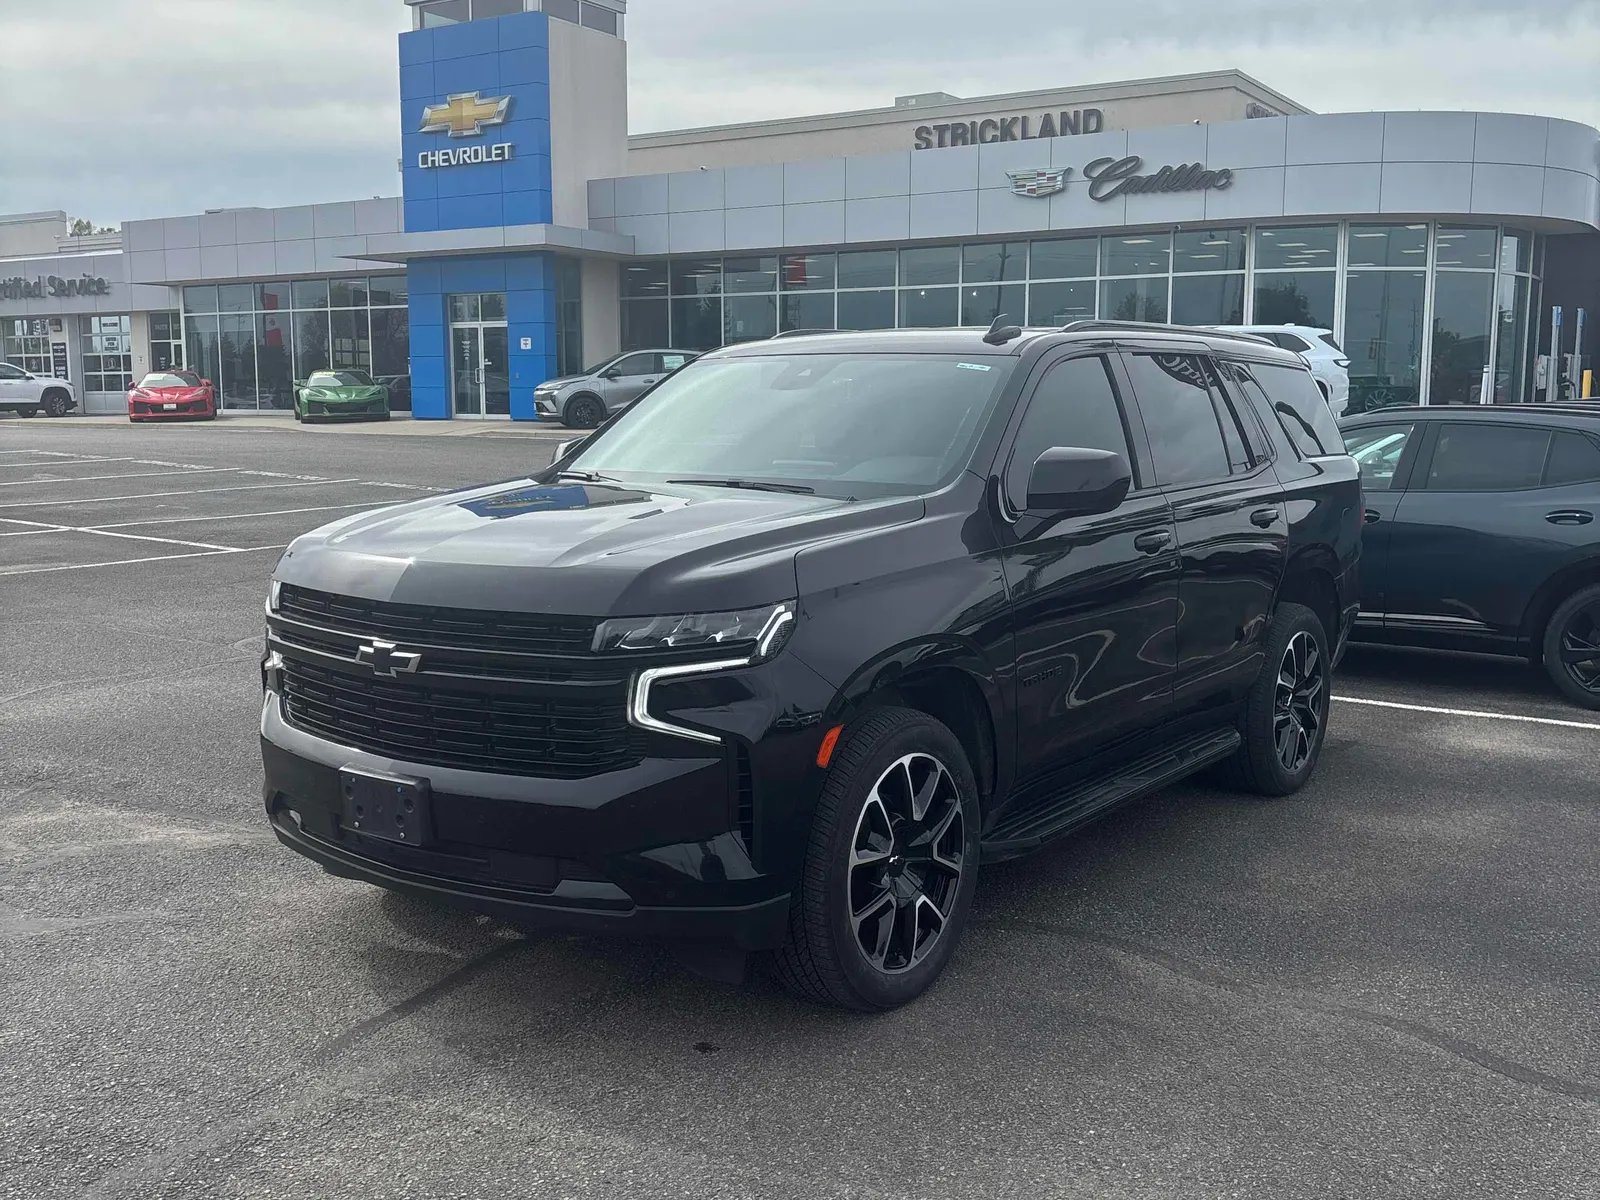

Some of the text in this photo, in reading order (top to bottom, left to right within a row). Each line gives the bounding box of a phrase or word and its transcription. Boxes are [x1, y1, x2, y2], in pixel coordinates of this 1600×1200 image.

[914, 108, 1104, 151] STRICKLAND
[418, 142, 513, 169] CHEVROLET
[1082, 155, 1234, 203] Cadillac
[48, 273, 110, 297] Service
